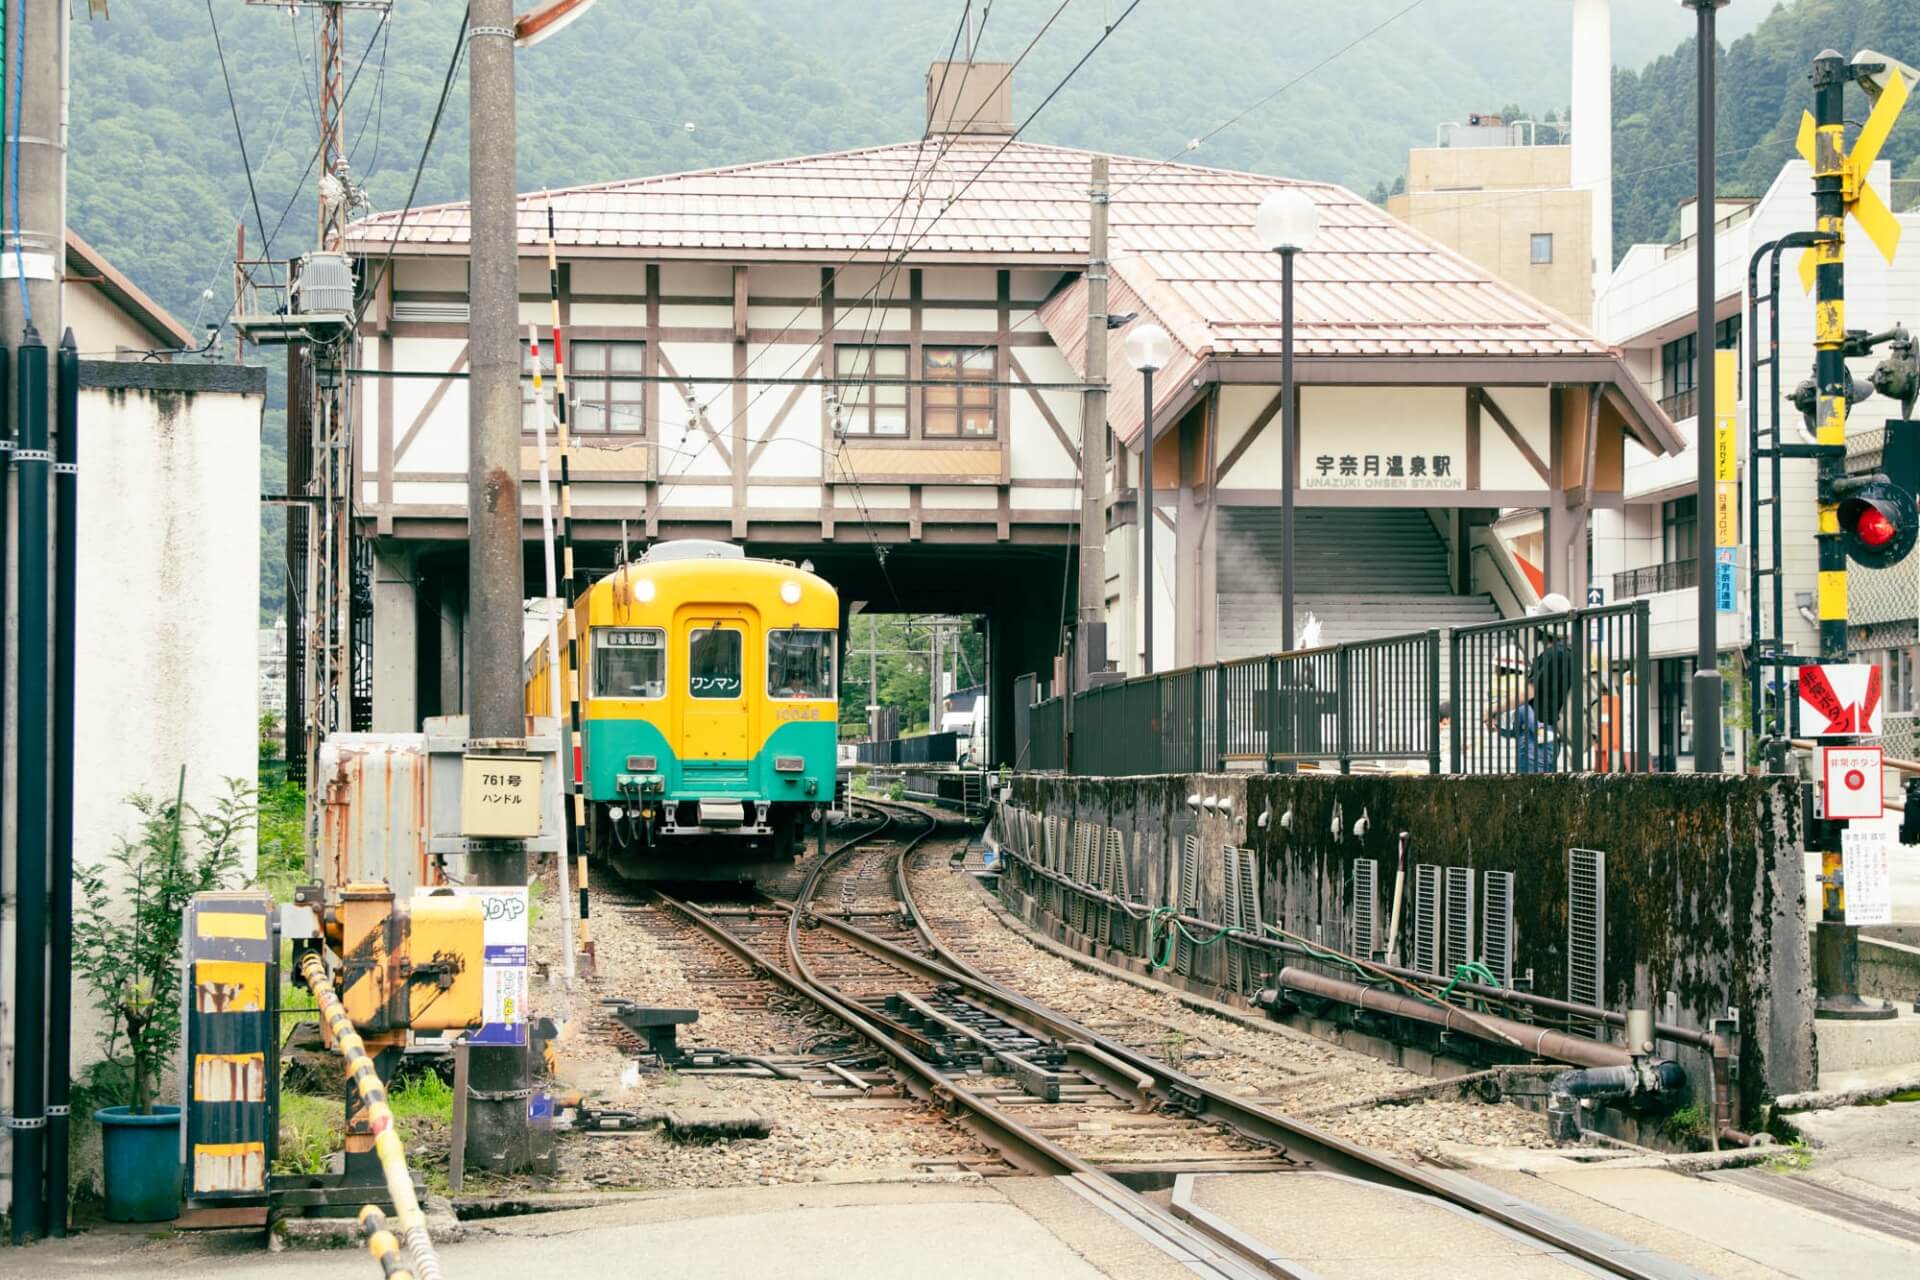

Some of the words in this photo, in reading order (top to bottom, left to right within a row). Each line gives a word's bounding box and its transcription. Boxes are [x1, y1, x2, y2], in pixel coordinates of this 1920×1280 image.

[1316, 455, 1452, 477] 宇奈月温泉駅
[1306, 478, 1361, 489] UNAZUKI
[1364, 478, 1407, 489] ONSEN
[1411, 478, 1462, 489] STATION
[691, 677, 740, 690] ワンマン
[1831, 758, 1879, 768] 非常ボタン
[482, 774, 523, 788] 761号
[482, 793, 523, 805] ハンドル
